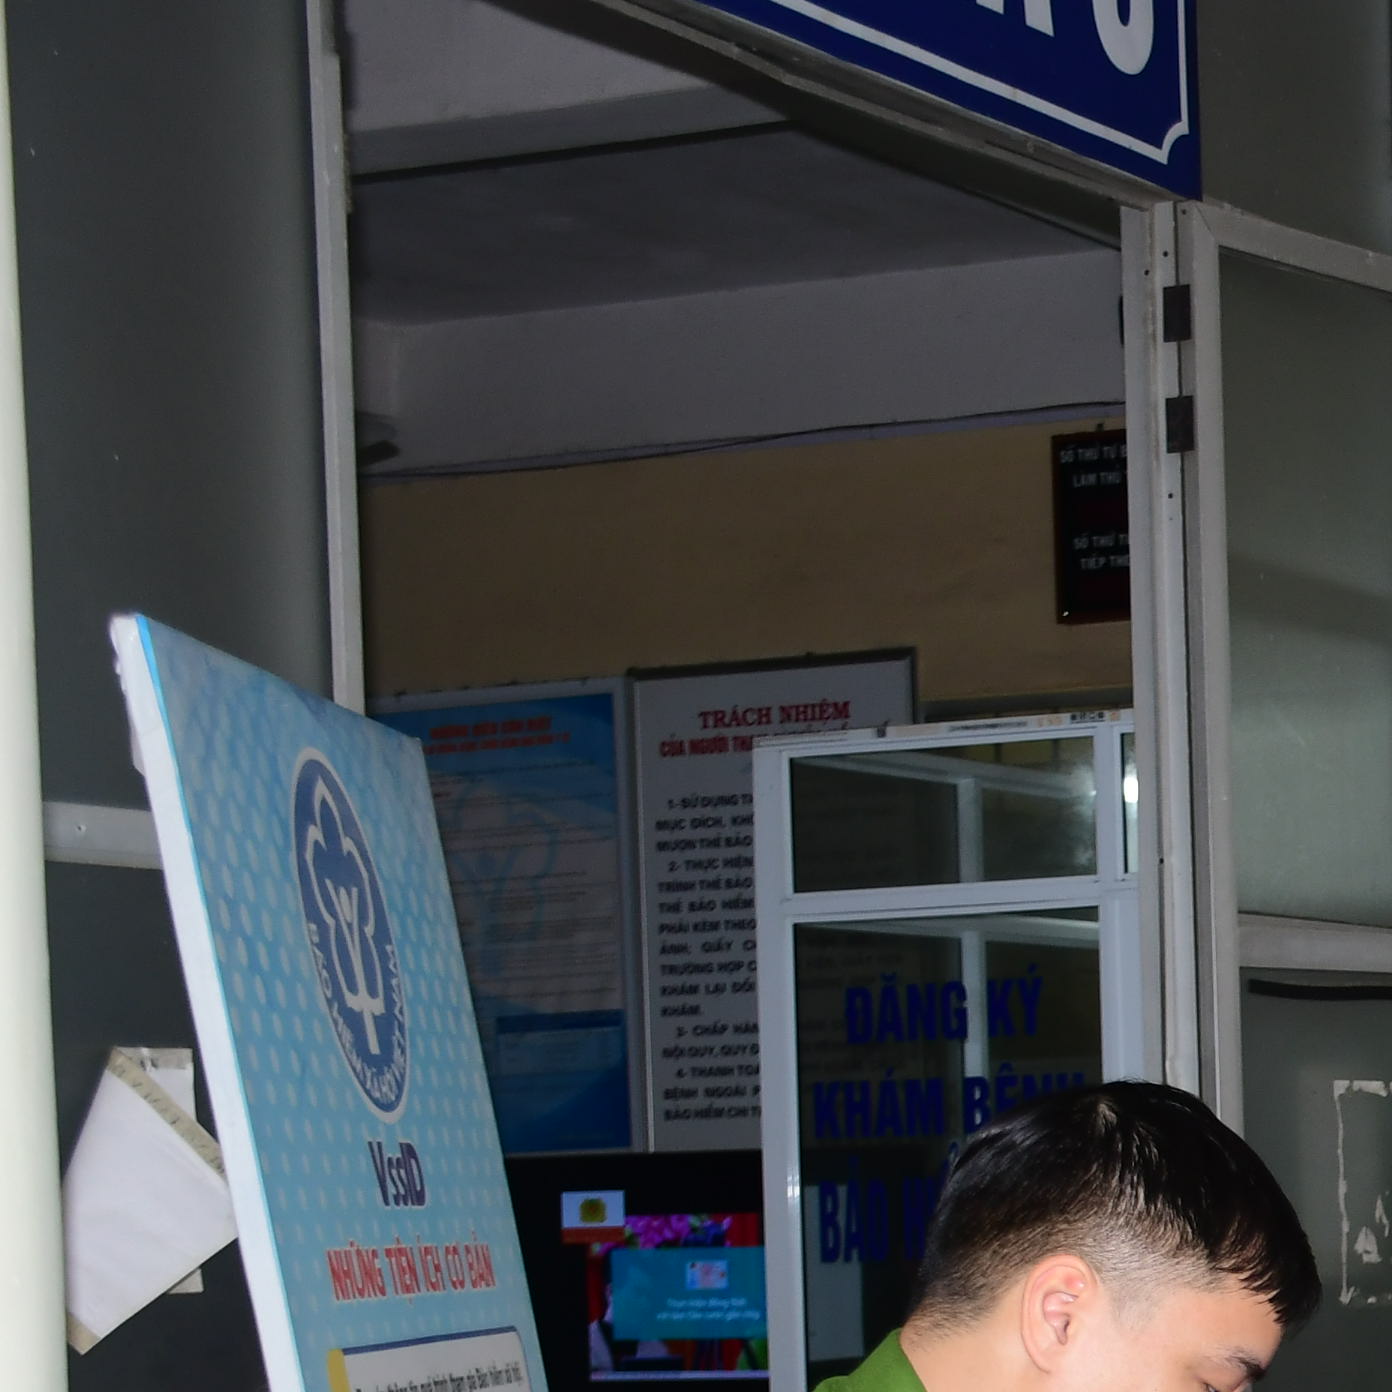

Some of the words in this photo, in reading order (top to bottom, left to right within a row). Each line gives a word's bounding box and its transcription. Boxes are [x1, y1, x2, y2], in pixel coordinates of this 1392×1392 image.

[699, 704, 772, 730] TRÁCH
[780, 698, 851, 725] NHIỆM
[845, 972, 969, 1045] ĐĂNG
[987, 963, 1043, 1038] KÝ
[813, 1066, 944, 1138] KHÁM
[367, 1140, 427, 1207] VssID
[819, 1153, 889, 1264] BẢO
[326, 1239, 386, 1302] NHỮNG
[385, 1235, 421, 1305] TIỆN
[417, 1234, 446, 1293] ÍCH
[464, 1231, 497, 1290] BẢN
